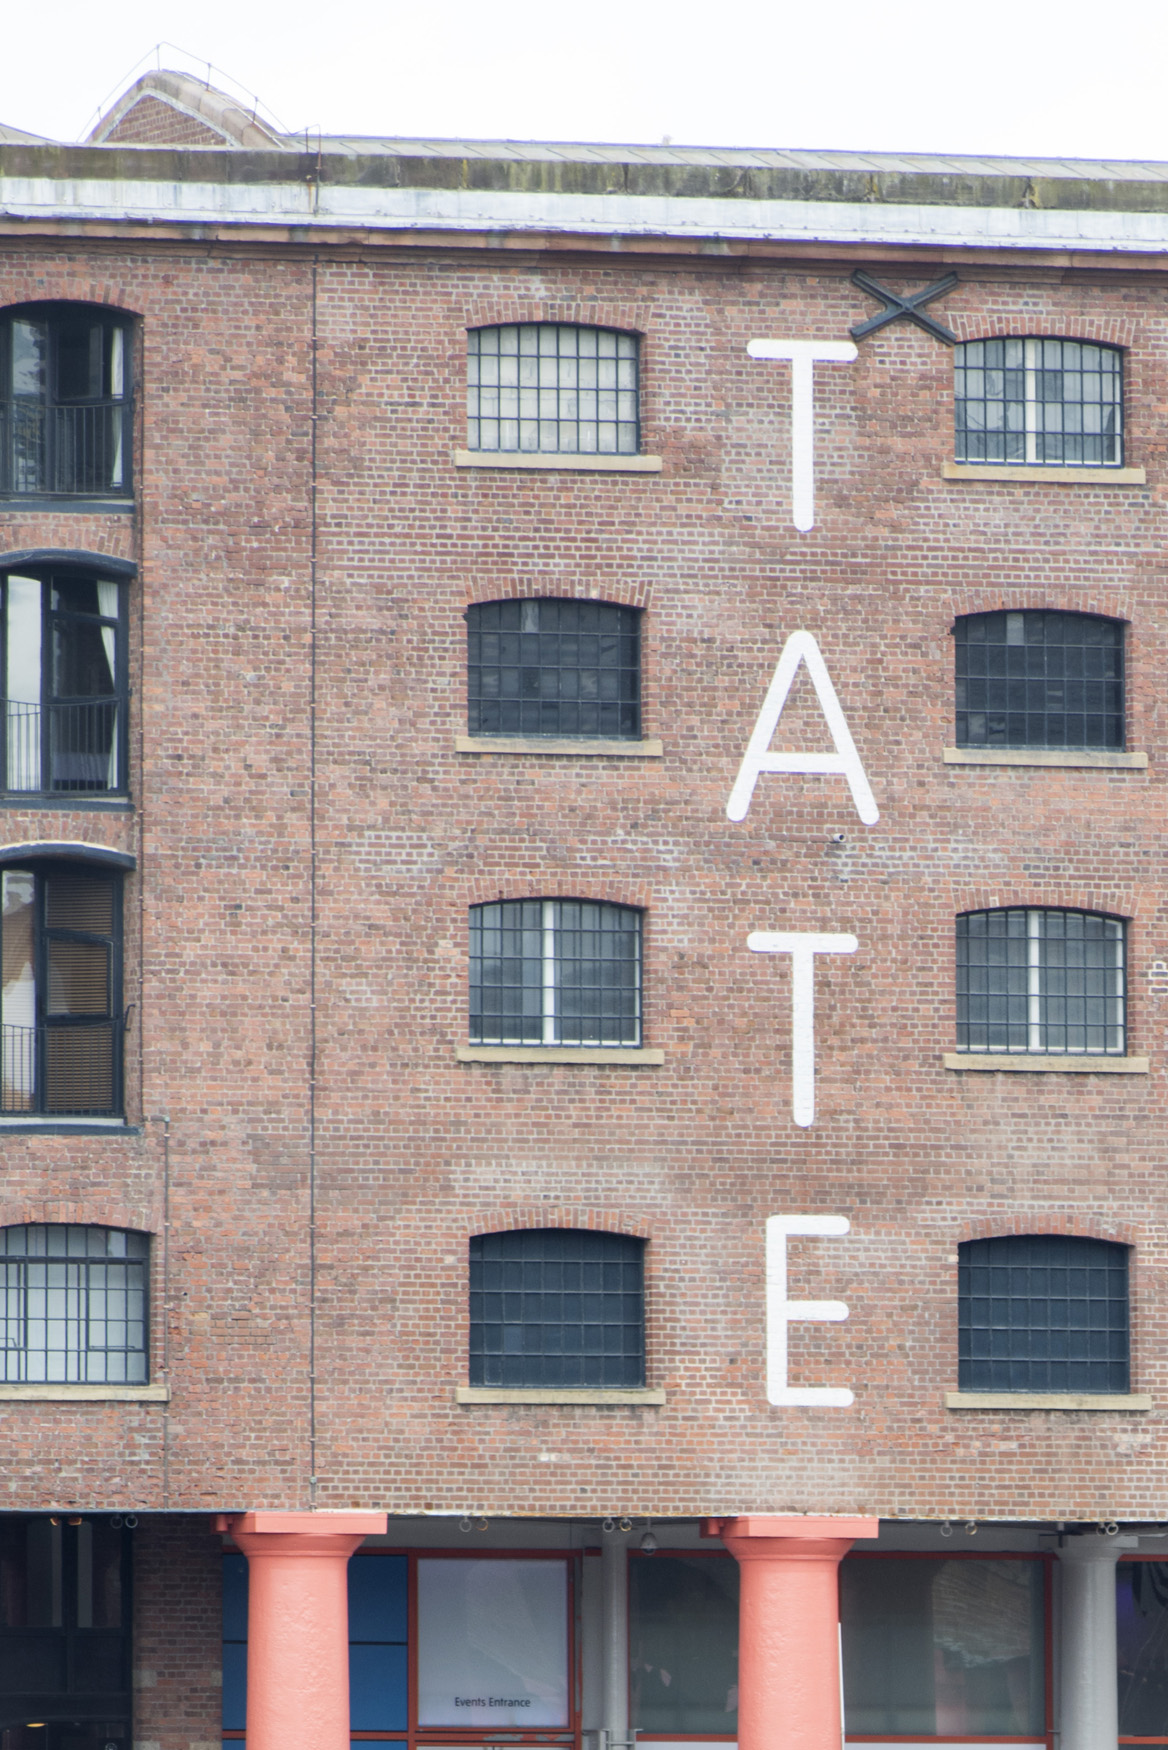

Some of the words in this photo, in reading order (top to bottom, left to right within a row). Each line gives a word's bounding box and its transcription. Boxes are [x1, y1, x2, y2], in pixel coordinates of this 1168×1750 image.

[726, 335, 881, 1410] TATE
[455, 1696, 486, 1707] Events
[488, 1697, 531, 1708] Entrance
